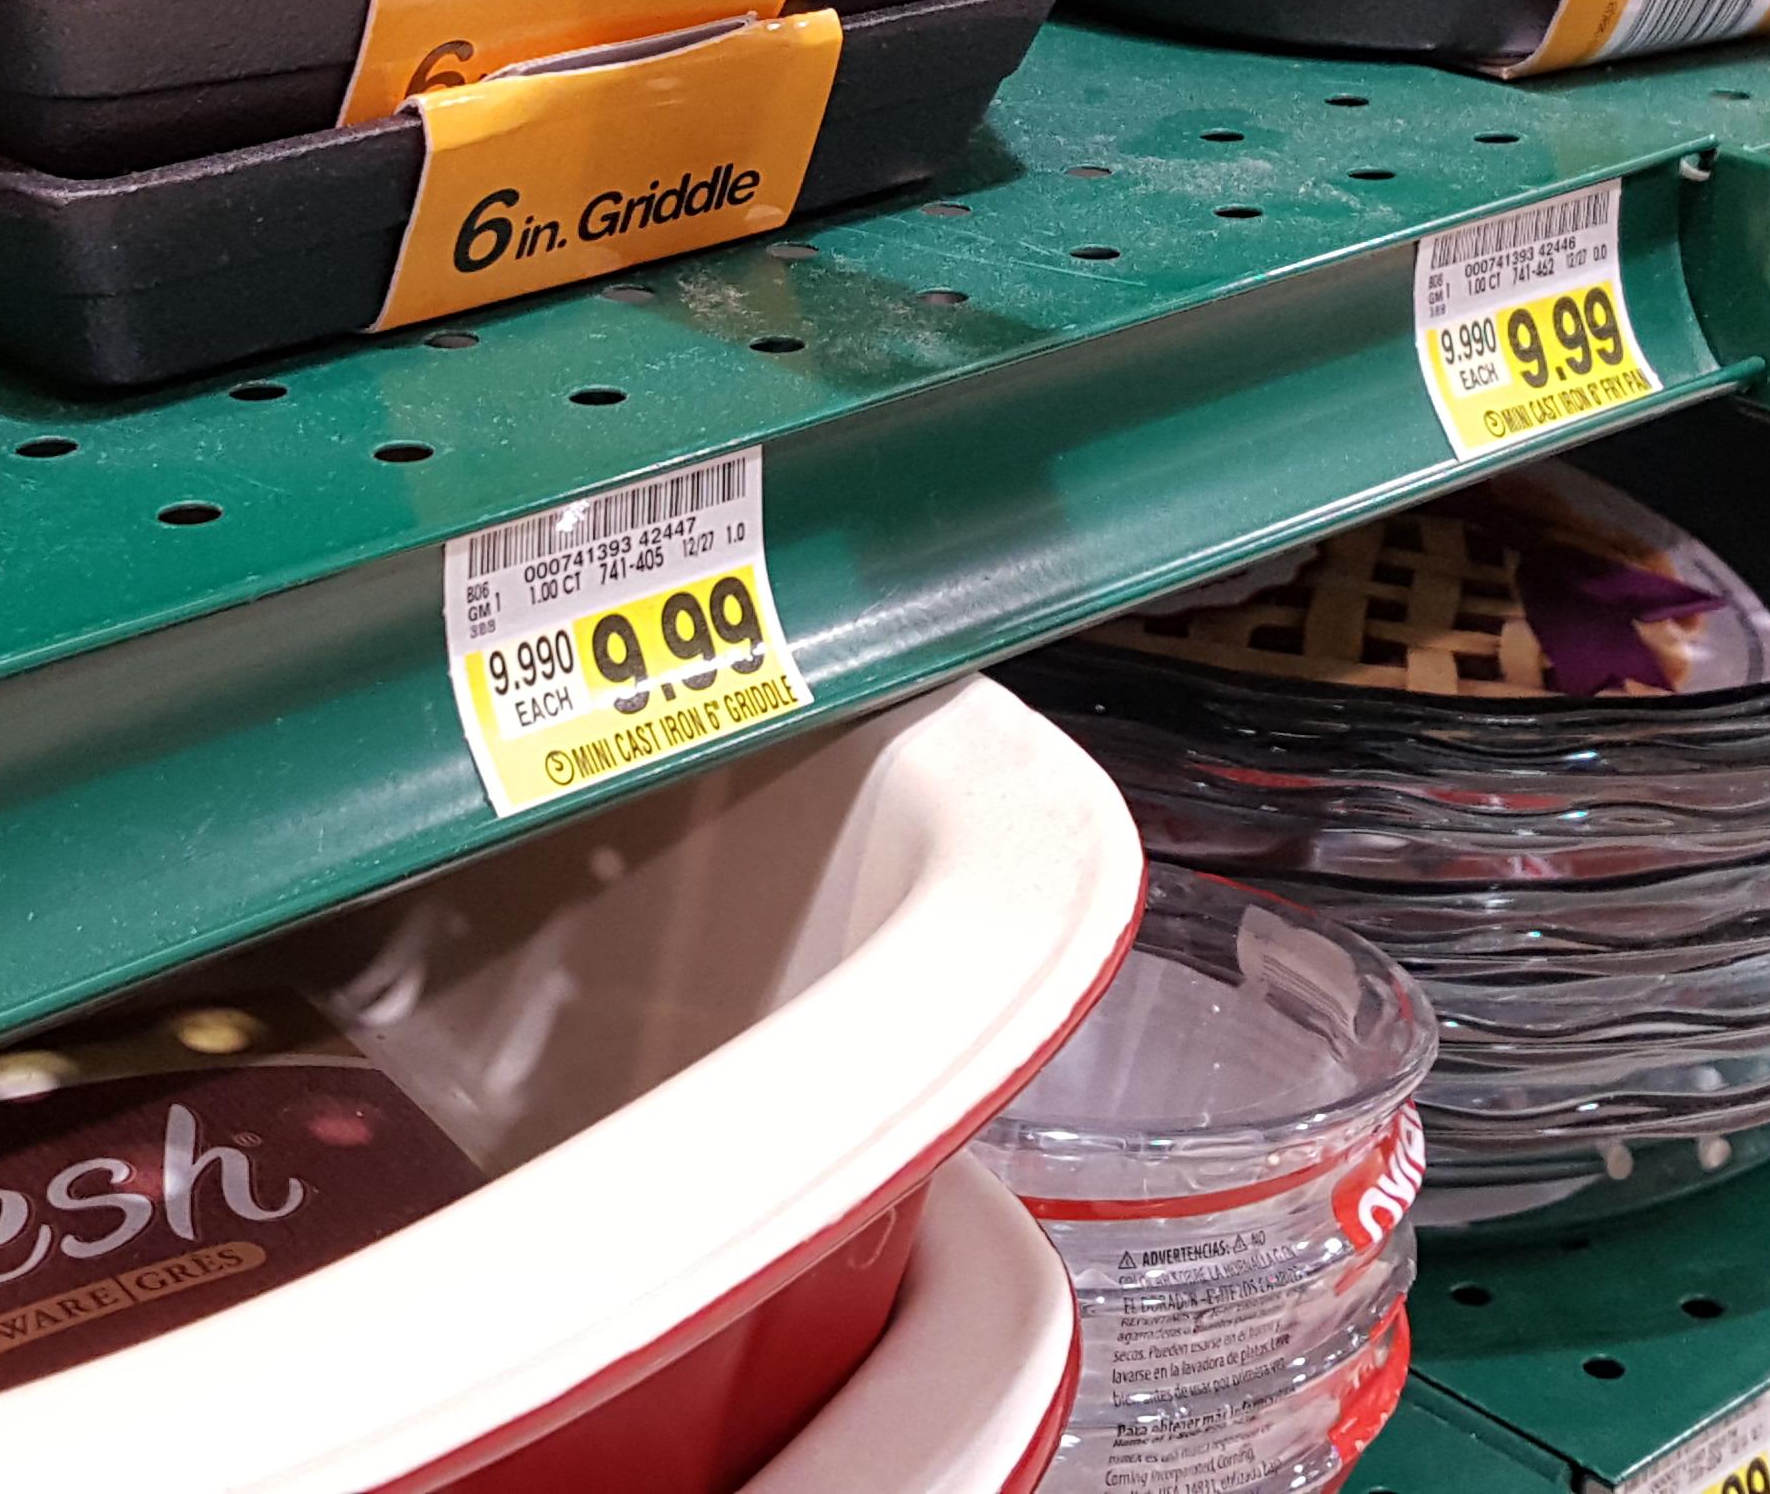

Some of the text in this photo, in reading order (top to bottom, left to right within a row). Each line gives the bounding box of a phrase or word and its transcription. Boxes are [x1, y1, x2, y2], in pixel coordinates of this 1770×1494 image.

[453, 162, 761, 274] 6 in. Griddle
[1440, 286, 1625, 389] 9.990 9.99
[1459, 362, 1499, 391] EACH
[1528, 392, 1561, 425] CAST
[1600, 374, 1626, 402] FRY
[523, 515, 698, 583] 000741393 42447
[529, 582, 559, 606] 1.00
[562, 571, 583, 594] CT
[599, 547, 665, 586] 741-405
[681, 530, 716, 559] 12/27
[726, 522, 747, 545] 1.0
[468, 602, 492, 622] GM
[488, 575, 765, 716] 9.990 9.99
[514, 685, 575, 728] EACH
[571, 738, 618, 779] MINI
[614, 720, 663, 764] CAST
[663, 706, 707, 746] IRON
[723, 674, 799, 724] GRIDDLE
[1142, 1239, 1230, 1267] ADVERTENCIAS:
[1112, 1367, 1152, 1385] lavarse
